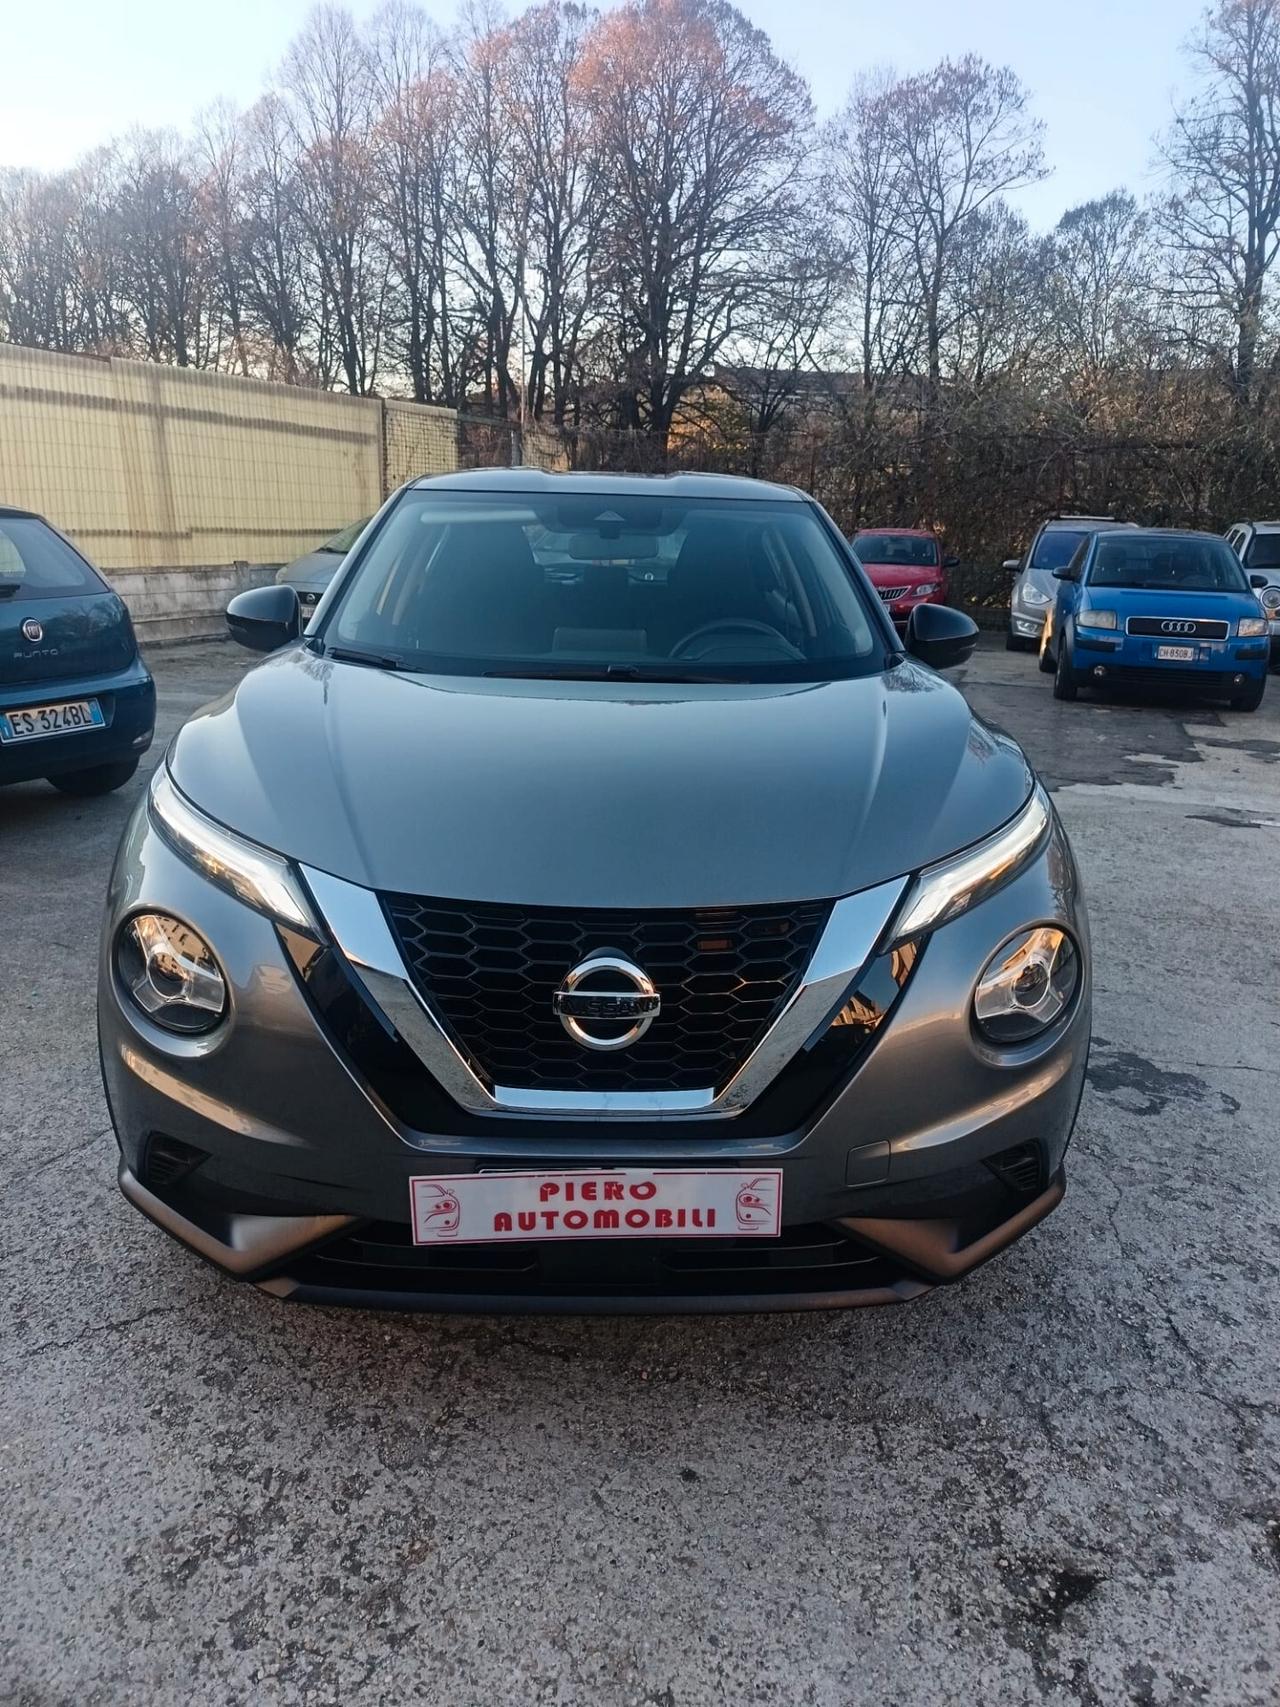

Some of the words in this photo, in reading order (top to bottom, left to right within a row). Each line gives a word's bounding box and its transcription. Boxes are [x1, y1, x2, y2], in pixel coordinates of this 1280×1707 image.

[13, 648, 59, 658] PUNTO
[8, 711, 35, 736] ES
[38, 704, 93, 731] 324BL
[539, 1181, 658, 1202] PIERO
[493, 1208, 717, 1233] AUTOMOBILI
